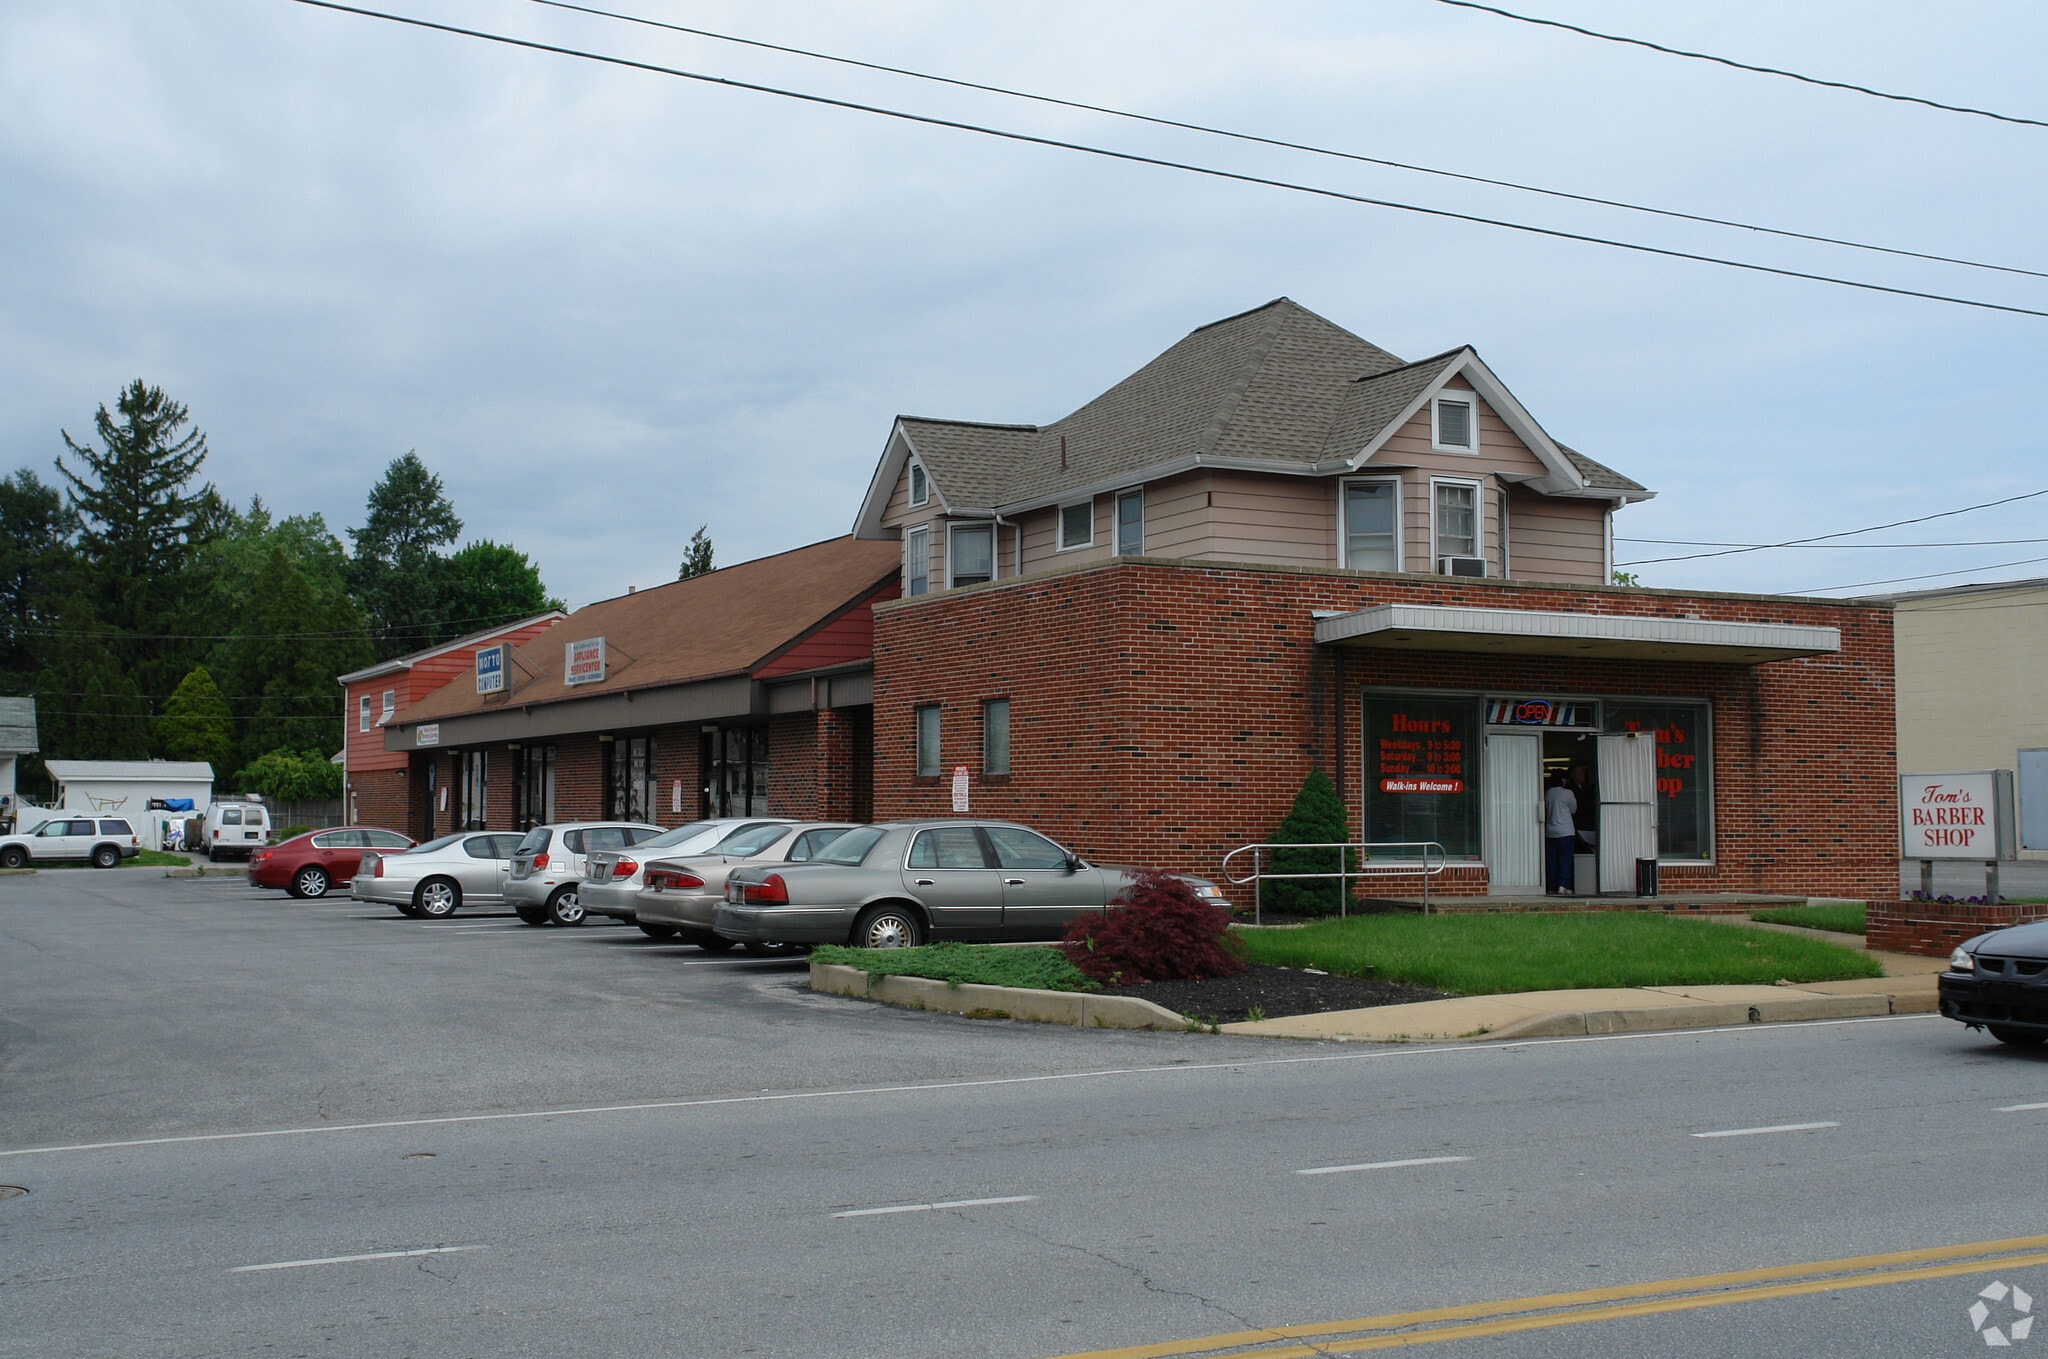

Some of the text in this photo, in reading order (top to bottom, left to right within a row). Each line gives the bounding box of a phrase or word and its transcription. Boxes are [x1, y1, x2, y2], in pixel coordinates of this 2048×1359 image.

[574, 649, 599, 662] APPLIANCE
[478, 674, 501, 692] COMPUTER
[1515, 704, 1551, 720] OPEN
[1392, 714, 1450, 732] Hours
[1624, 720, 1684, 743] Tm's
[1380, 739, 1460, 751] Weekdays 9 to 5:30
[1380, 751, 1416, 763] Saturday
[1427, 752, 1432, 761] 9
[1434, 752, 1441, 762] to
[1656, 746, 1695, 769] ber
[1380, 763, 1409, 775] Sunday
[1427, 764, 1435, 774] 10
[1386, 781, 1417, 791] Walk-ins
[1419, 781, 1453, 791] Welcome
[1656, 777, 1683, 799] op
[1921, 784, 1972, 804] Tom's
[1912, 807, 1985, 826] BARBER
[1924, 829, 1975, 847] SHOP
